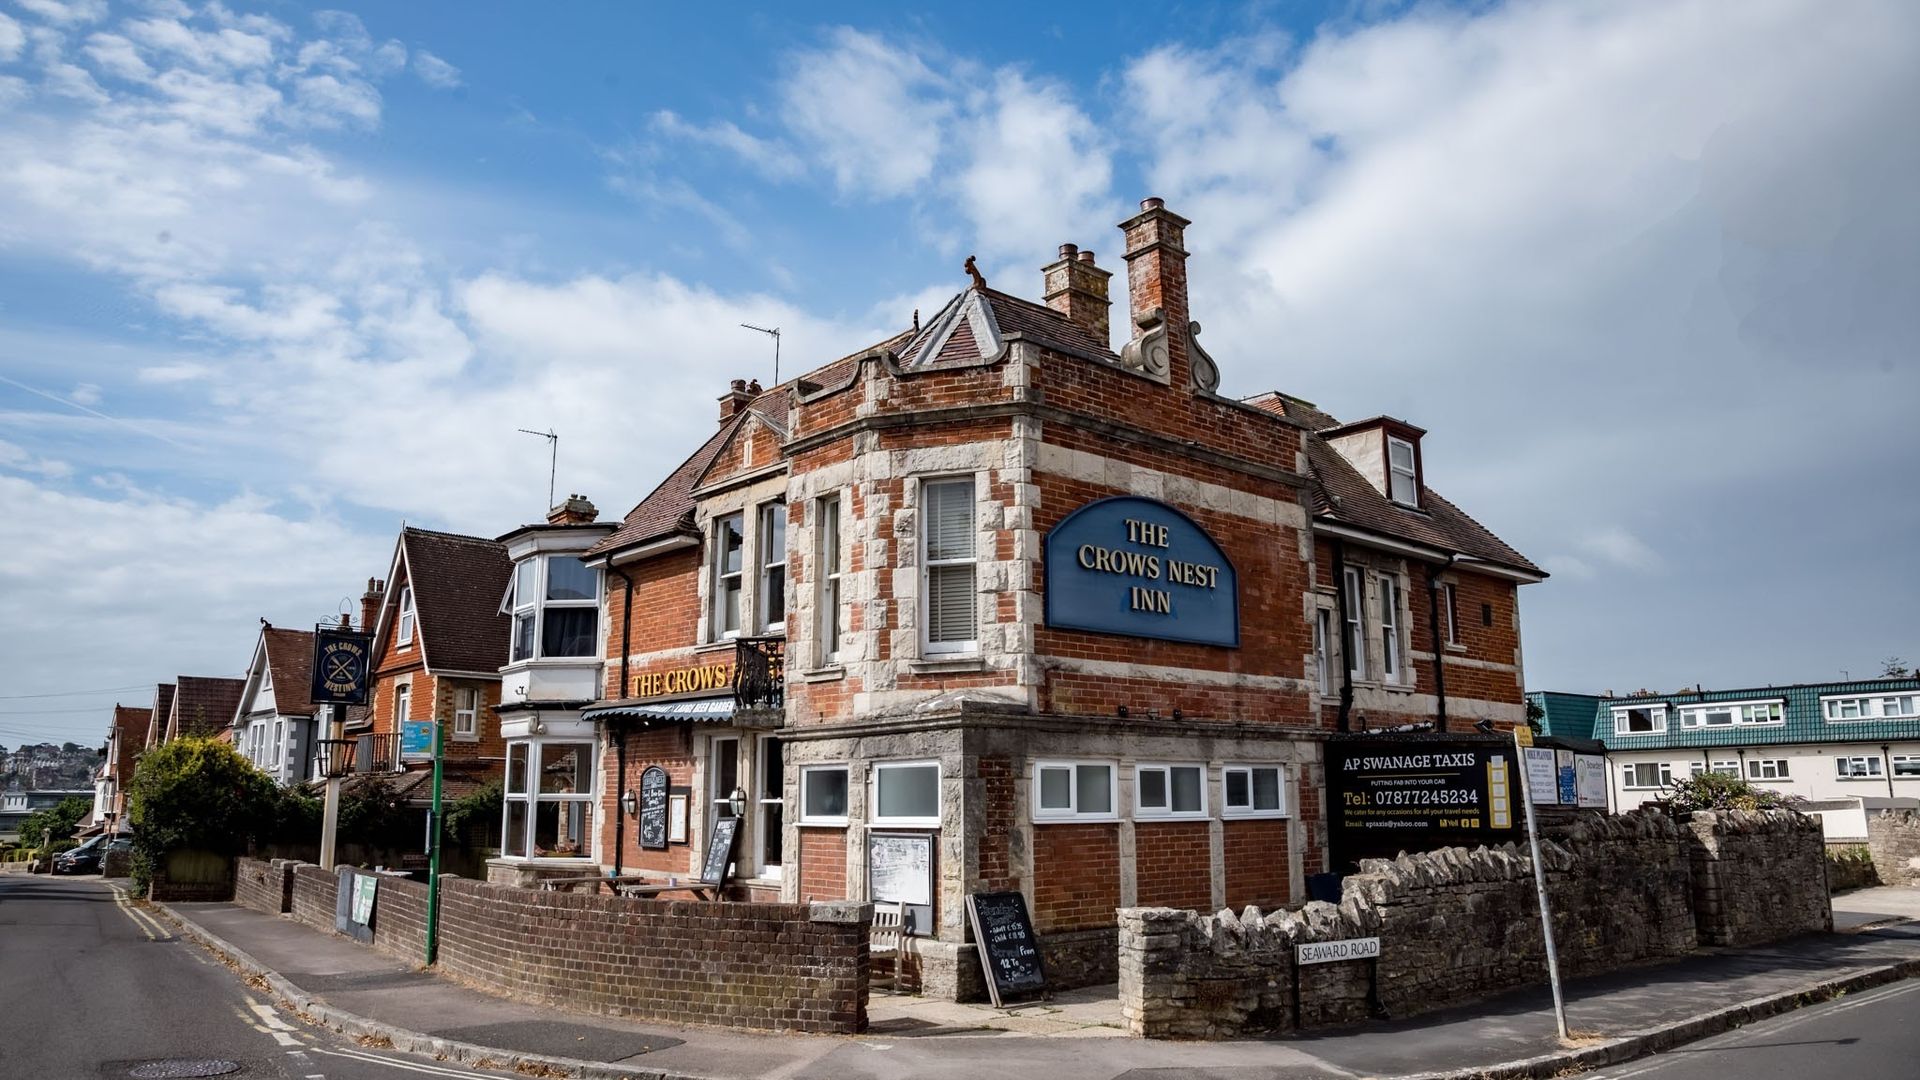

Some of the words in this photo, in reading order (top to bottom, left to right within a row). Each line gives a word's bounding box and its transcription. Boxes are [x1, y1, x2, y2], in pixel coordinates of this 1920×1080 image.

[1125, 518, 1170, 548] THE
[1079, 544, 1161, 579] CROWS
[1168, 559, 1219, 588] NEST
[1131, 586, 1171, 613] INN
[324, 643, 338, 654] THE
[338, 642, 363, 656] CROWS
[632, 674, 662, 697] THE
[665, 664, 728, 693] CROWS
[708, 701, 736, 713] GARDEN
[1343, 758, 1361, 771] AP
[1363, 755, 1431, 770] SWANAGE
[1433, 753, 1476, 768] TAXIS
[1343, 791, 1371, 805] Tel:
[1375, 789, 1479, 805] 07877245234
[1365, 820, 1429, 829] aptaxis@yahoo.com
[1302, 944, 1348, 961] SEAWARD
[1351, 941, 1377, 956] ROAD
[1000, 958, 1011, 969] 12
[1011, 958, 1020, 967] To
